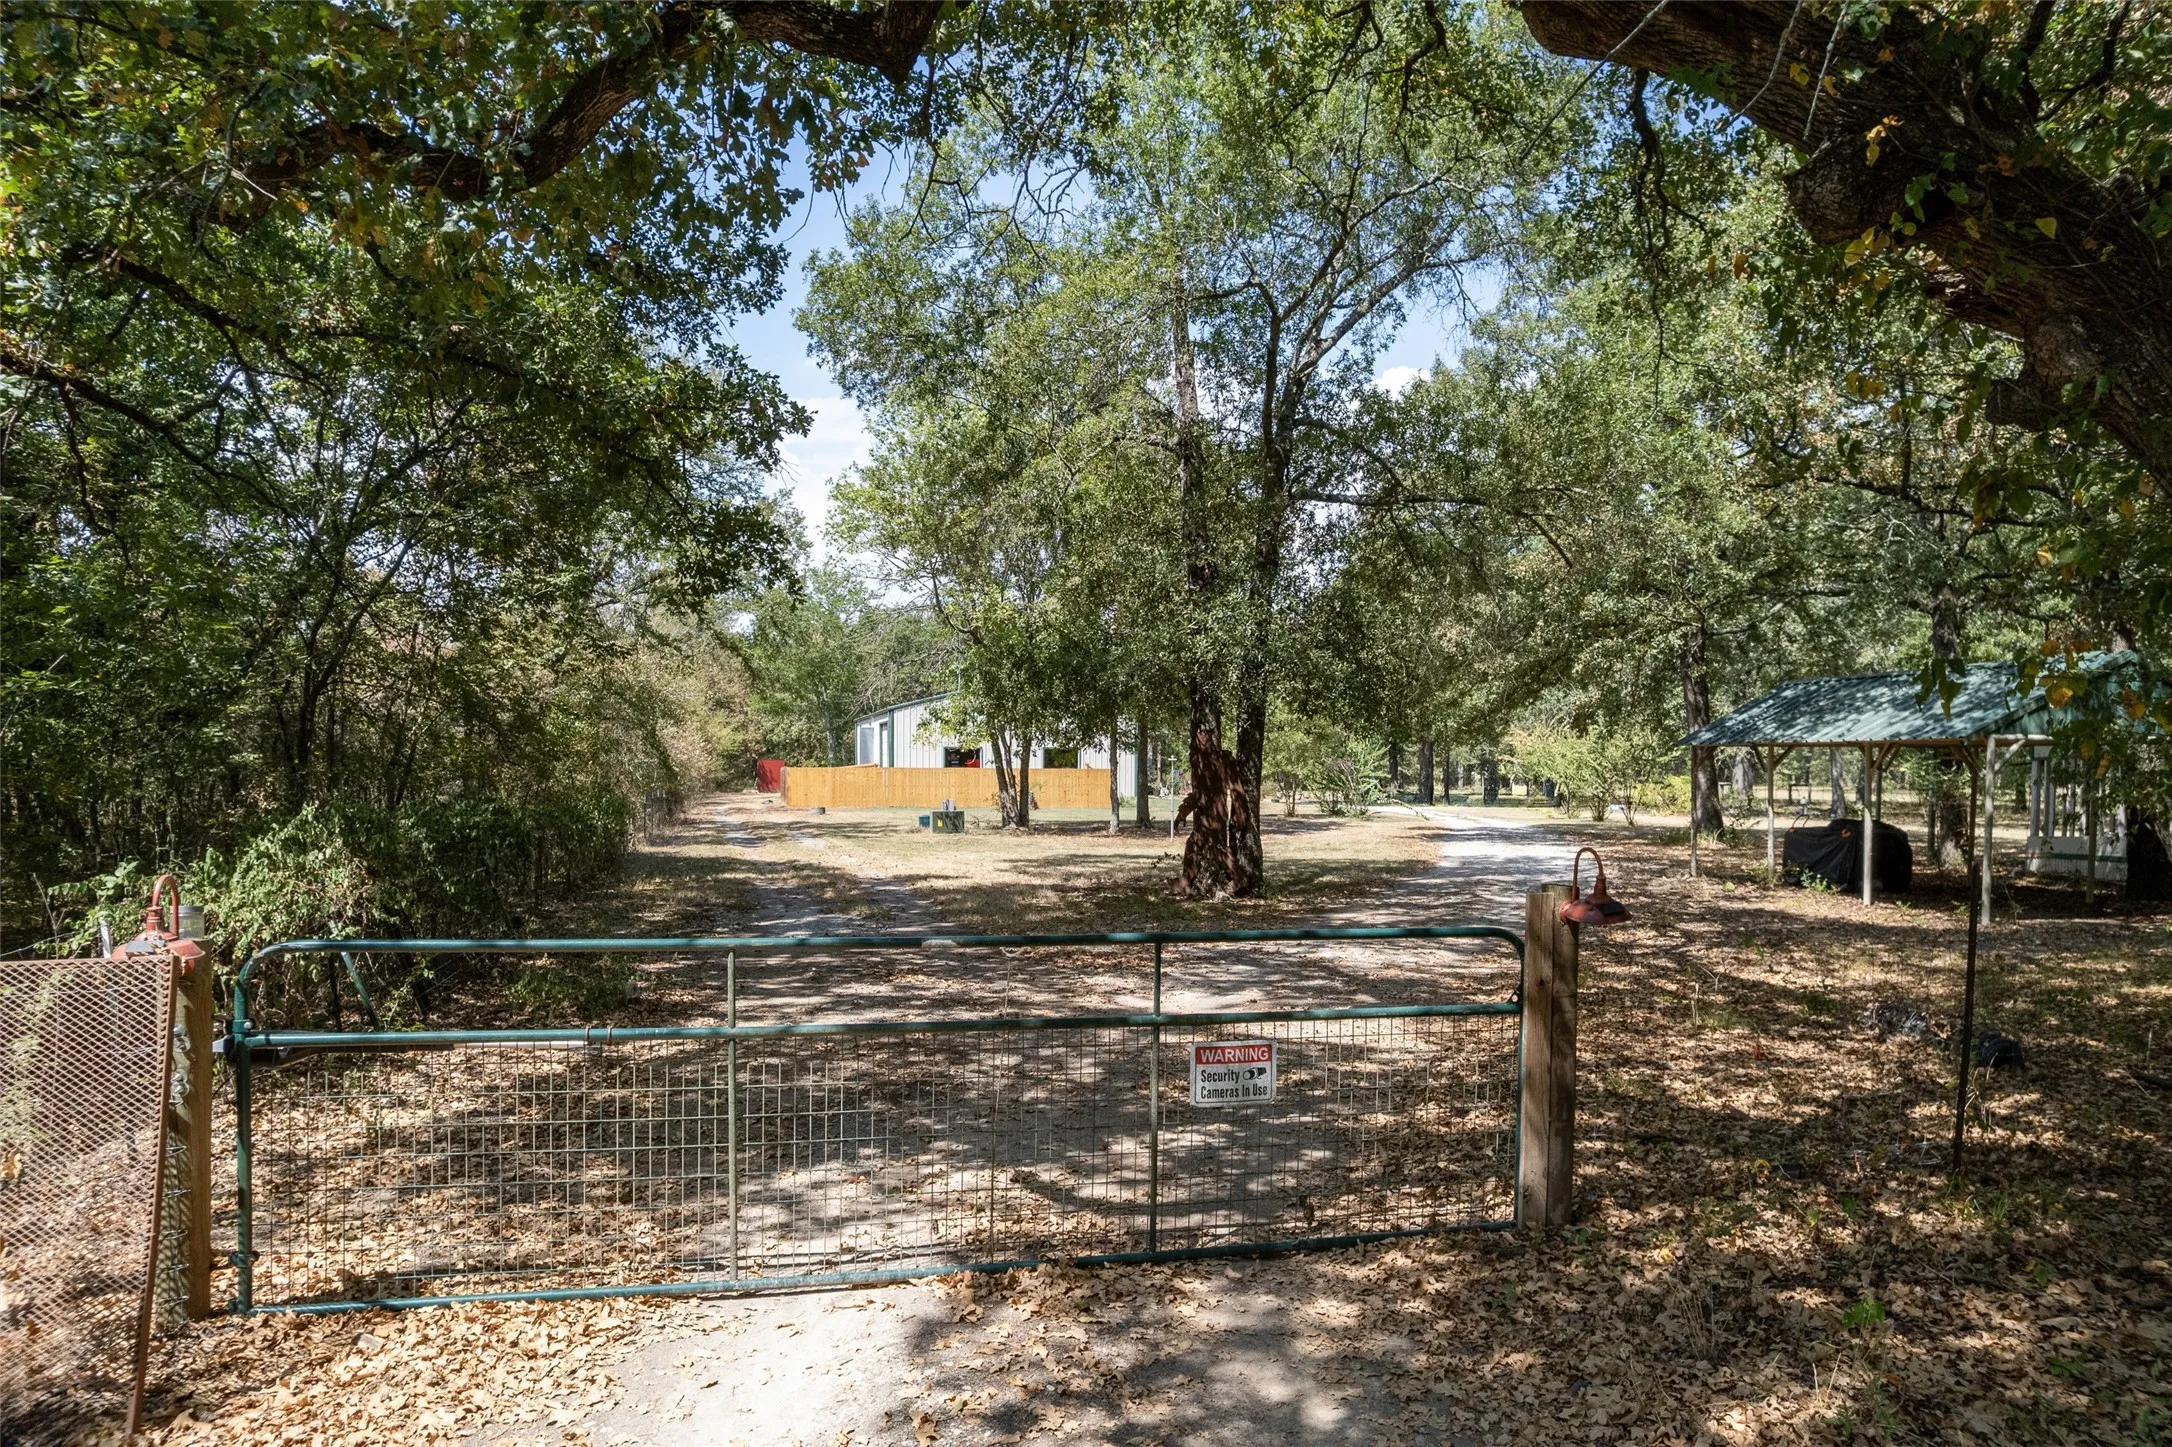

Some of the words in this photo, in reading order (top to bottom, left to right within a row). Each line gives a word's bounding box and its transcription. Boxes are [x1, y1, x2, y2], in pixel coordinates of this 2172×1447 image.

[1200, 1047, 1269, 1063] WARNING
[1201, 1069, 1240, 1084] Security
[1201, 1086, 1239, 1099] Cameras
[1242, 1084, 1250, 1097] In
[1252, 1083, 1268, 1097] Use
